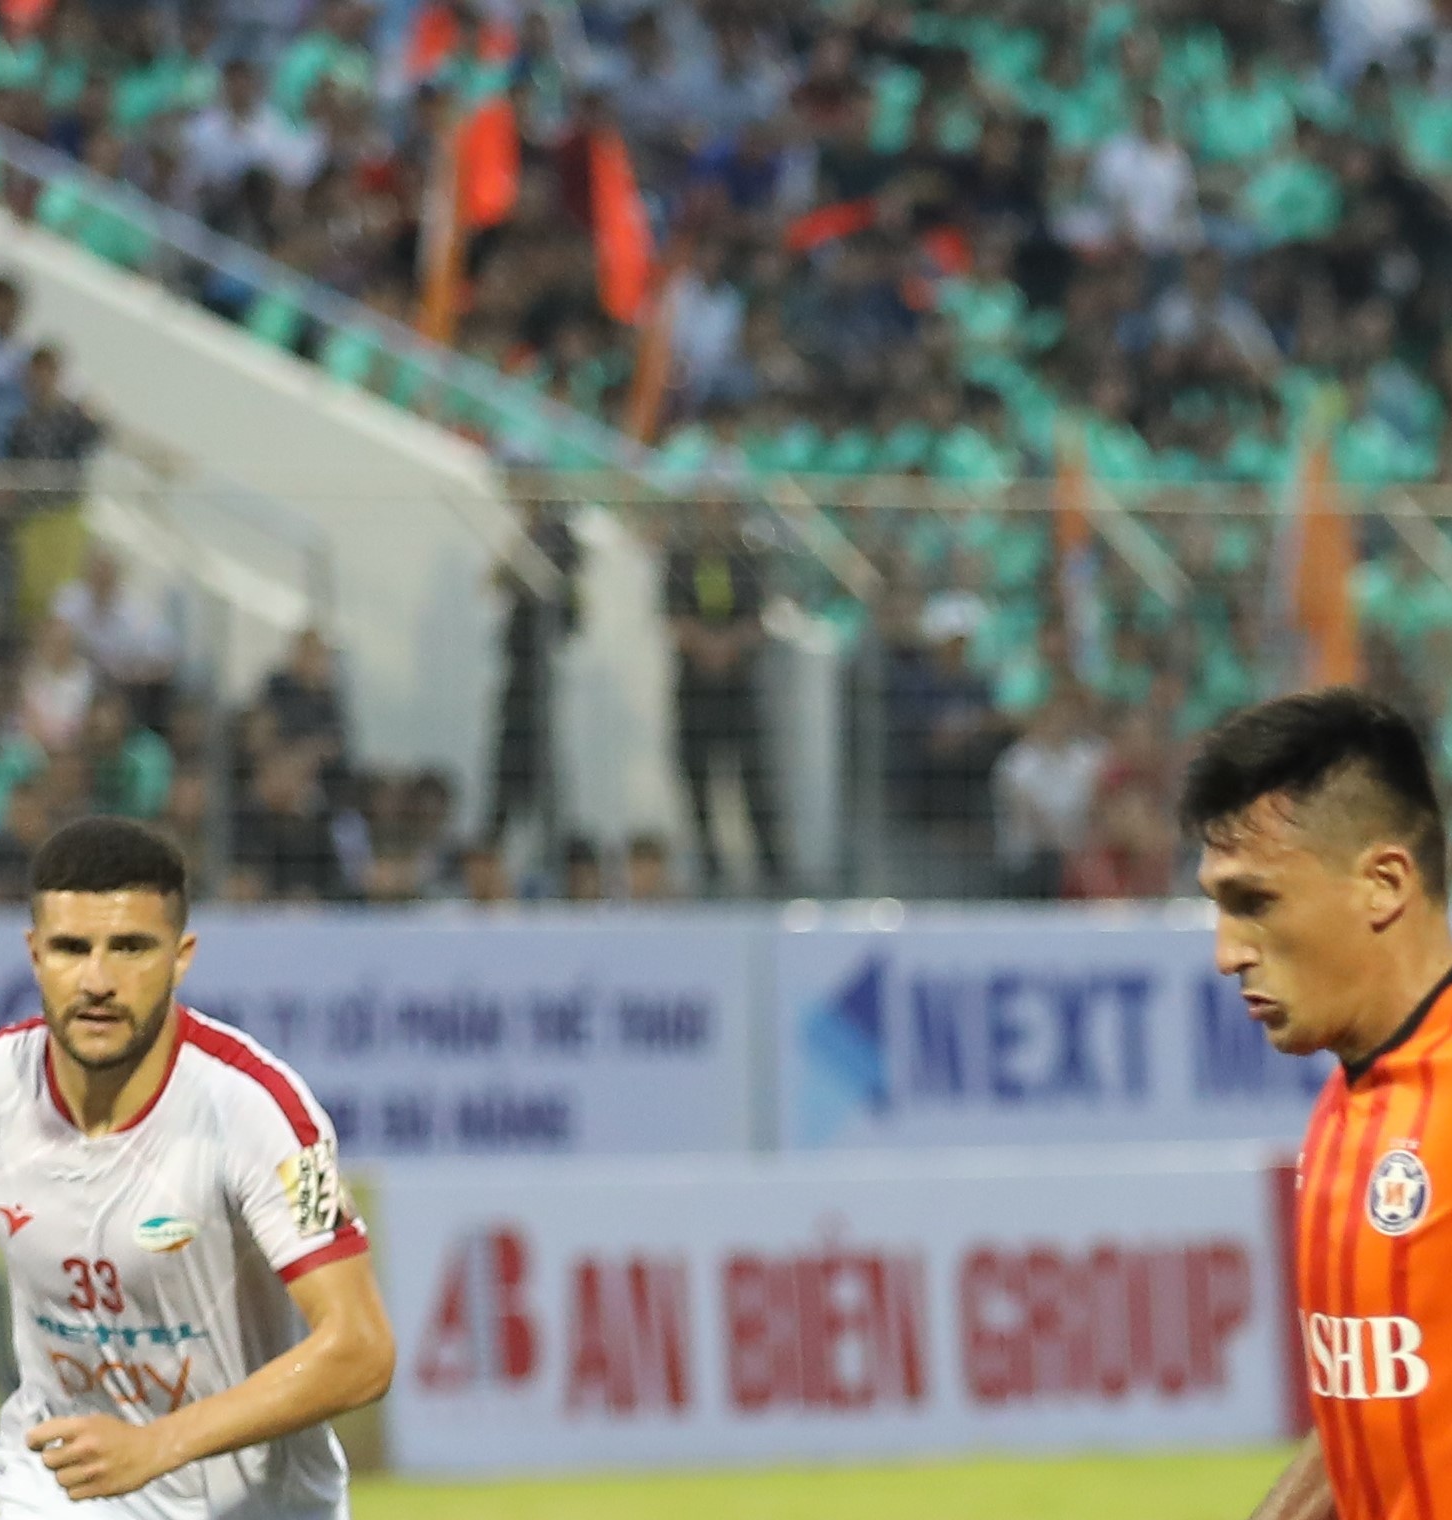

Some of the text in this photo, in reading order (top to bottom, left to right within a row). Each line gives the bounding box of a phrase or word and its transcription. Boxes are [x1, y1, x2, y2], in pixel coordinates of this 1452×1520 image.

[914, 966, 1151, 1102] NEXT
[63, 1257, 125, 1314] 33
[565, 1254, 689, 1414] AN
[959, 1240, 1250, 1404] GROUP
[1308, 1312, 1431, 1400] SHB
